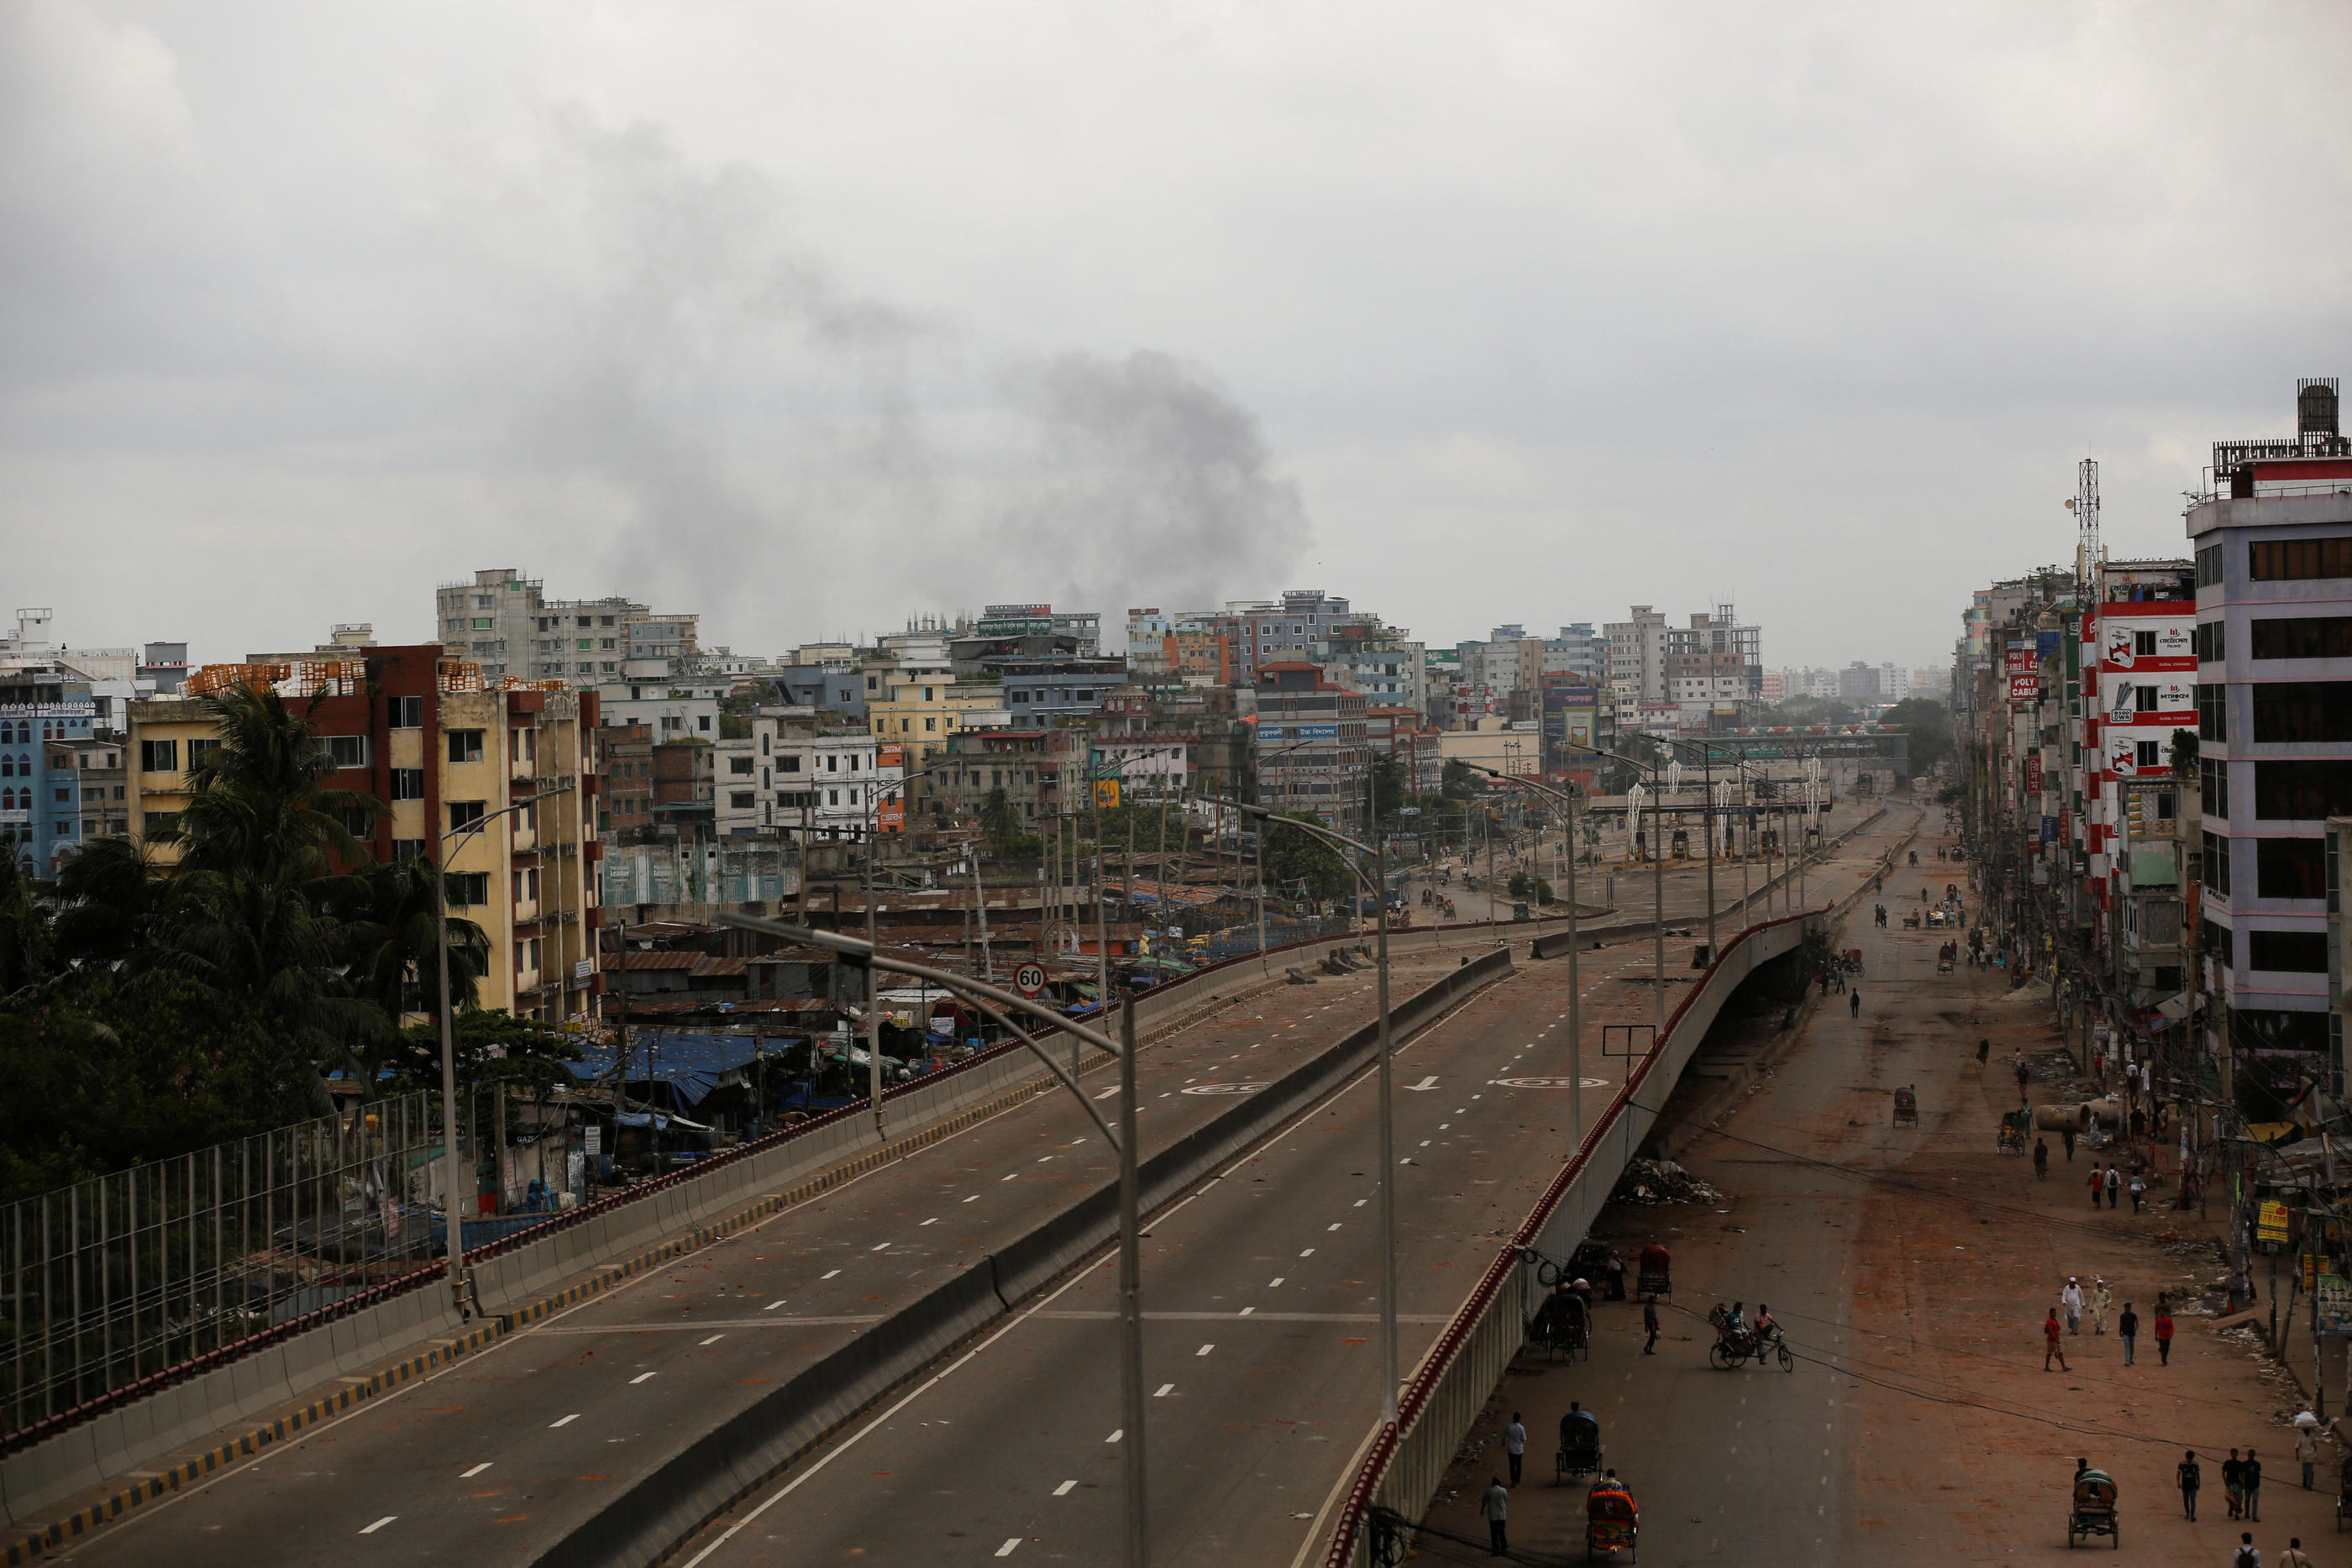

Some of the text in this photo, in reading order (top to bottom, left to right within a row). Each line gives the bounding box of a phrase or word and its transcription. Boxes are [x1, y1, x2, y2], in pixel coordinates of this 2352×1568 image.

[2015, 678, 2034, 686] POLY
[880, 813, 902, 821] CSRM
[1019, 970, 1041, 986] 60
